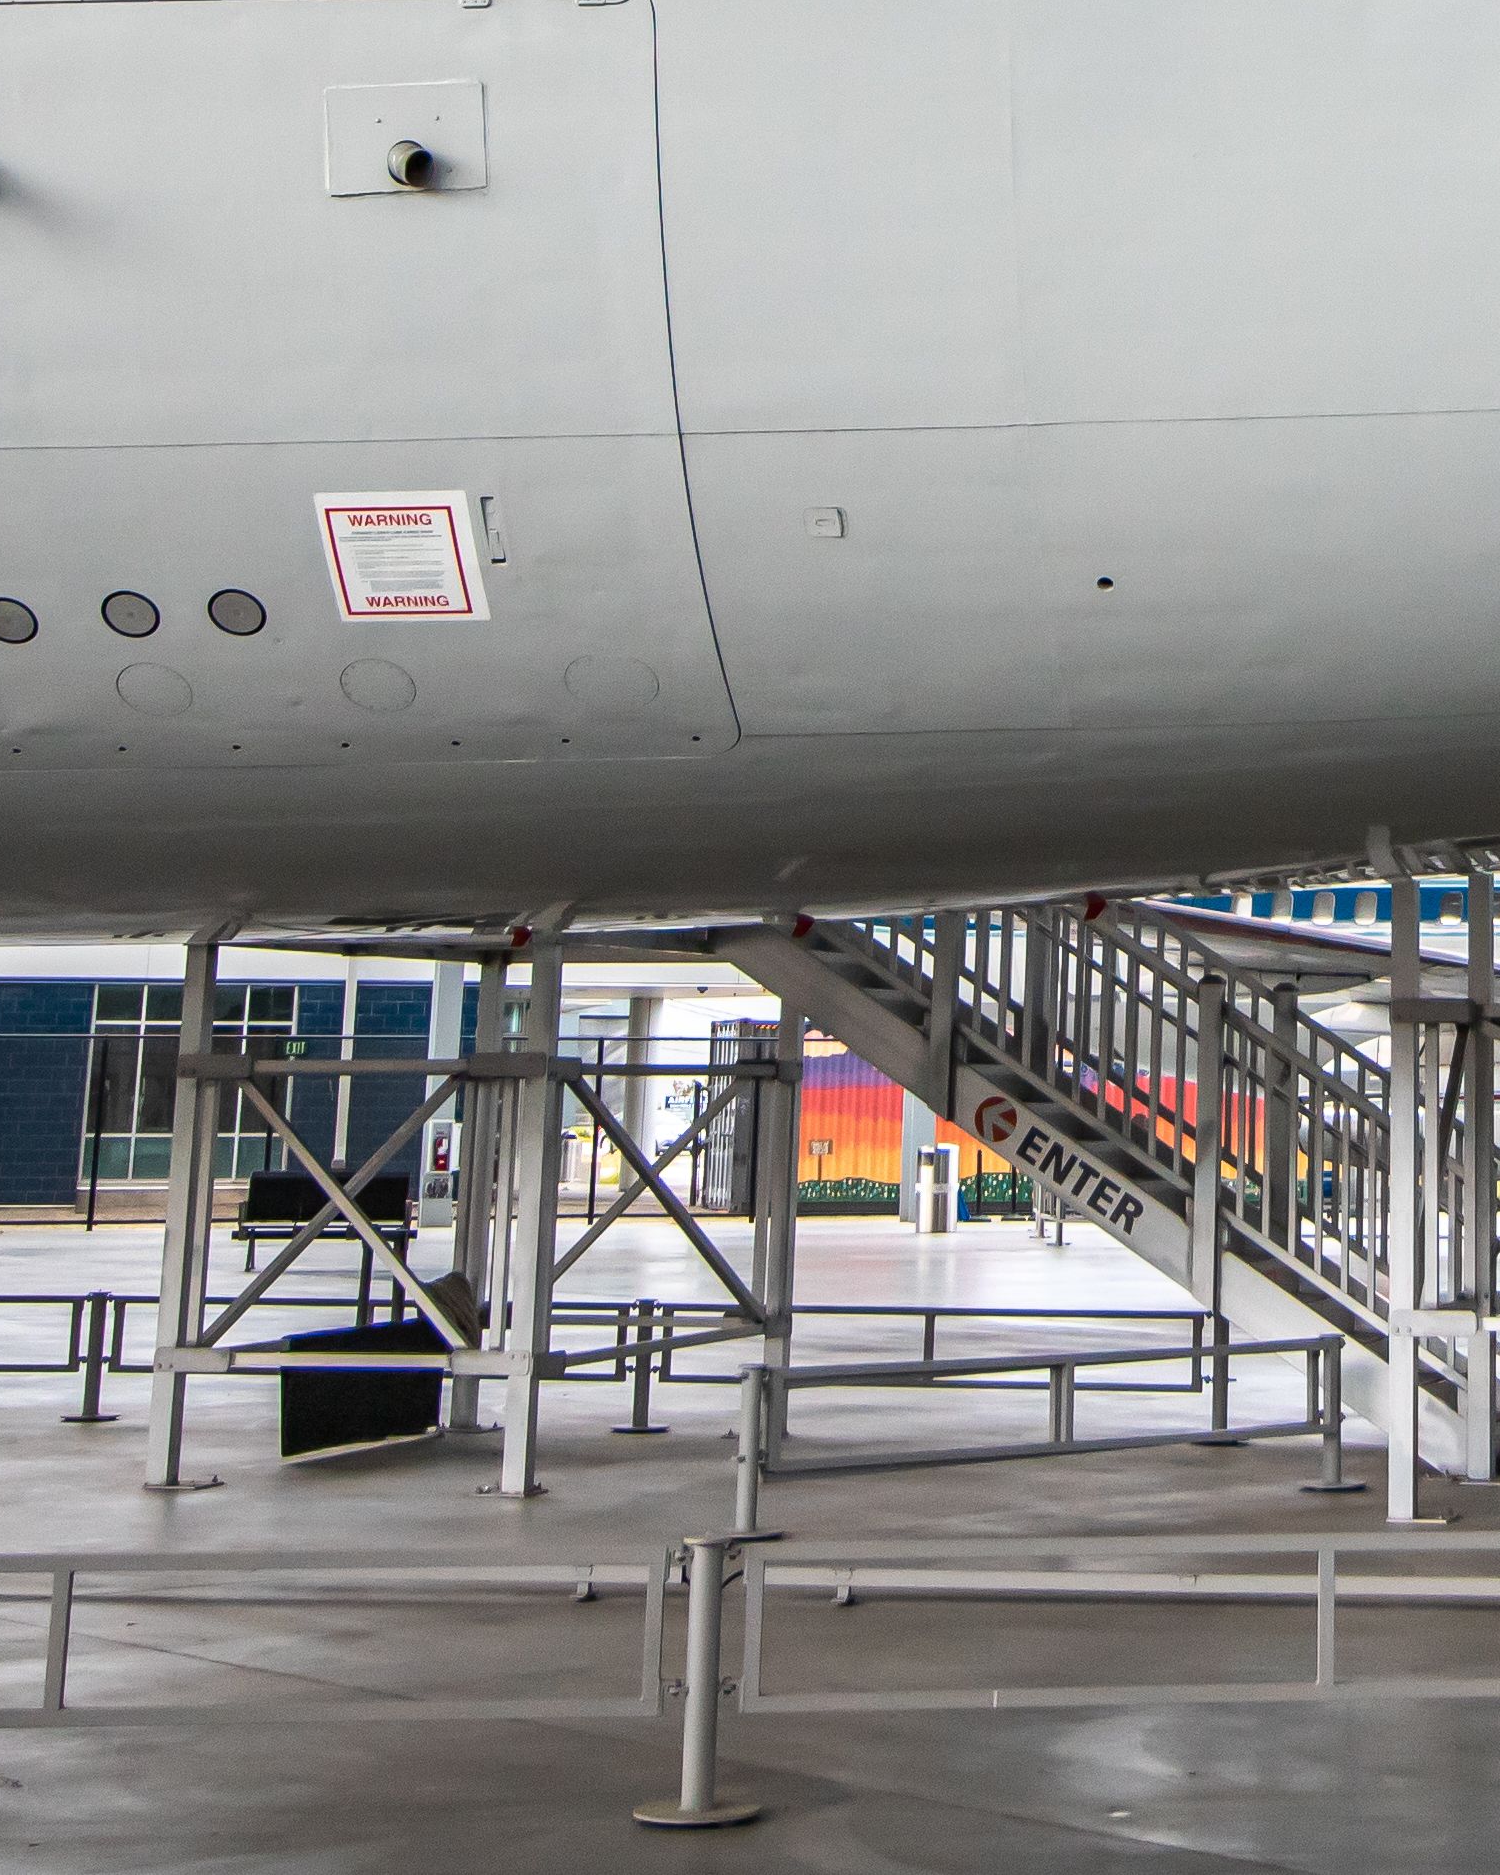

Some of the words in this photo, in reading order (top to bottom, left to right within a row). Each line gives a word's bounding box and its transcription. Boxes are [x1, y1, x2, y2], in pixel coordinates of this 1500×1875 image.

[347, 513, 432, 527] WARNING
[366, 595, 449, 608] WARNING
[286, 1041, 306, 1055] EXIT
[1015, 1126, 1144, 1236] ENTER
